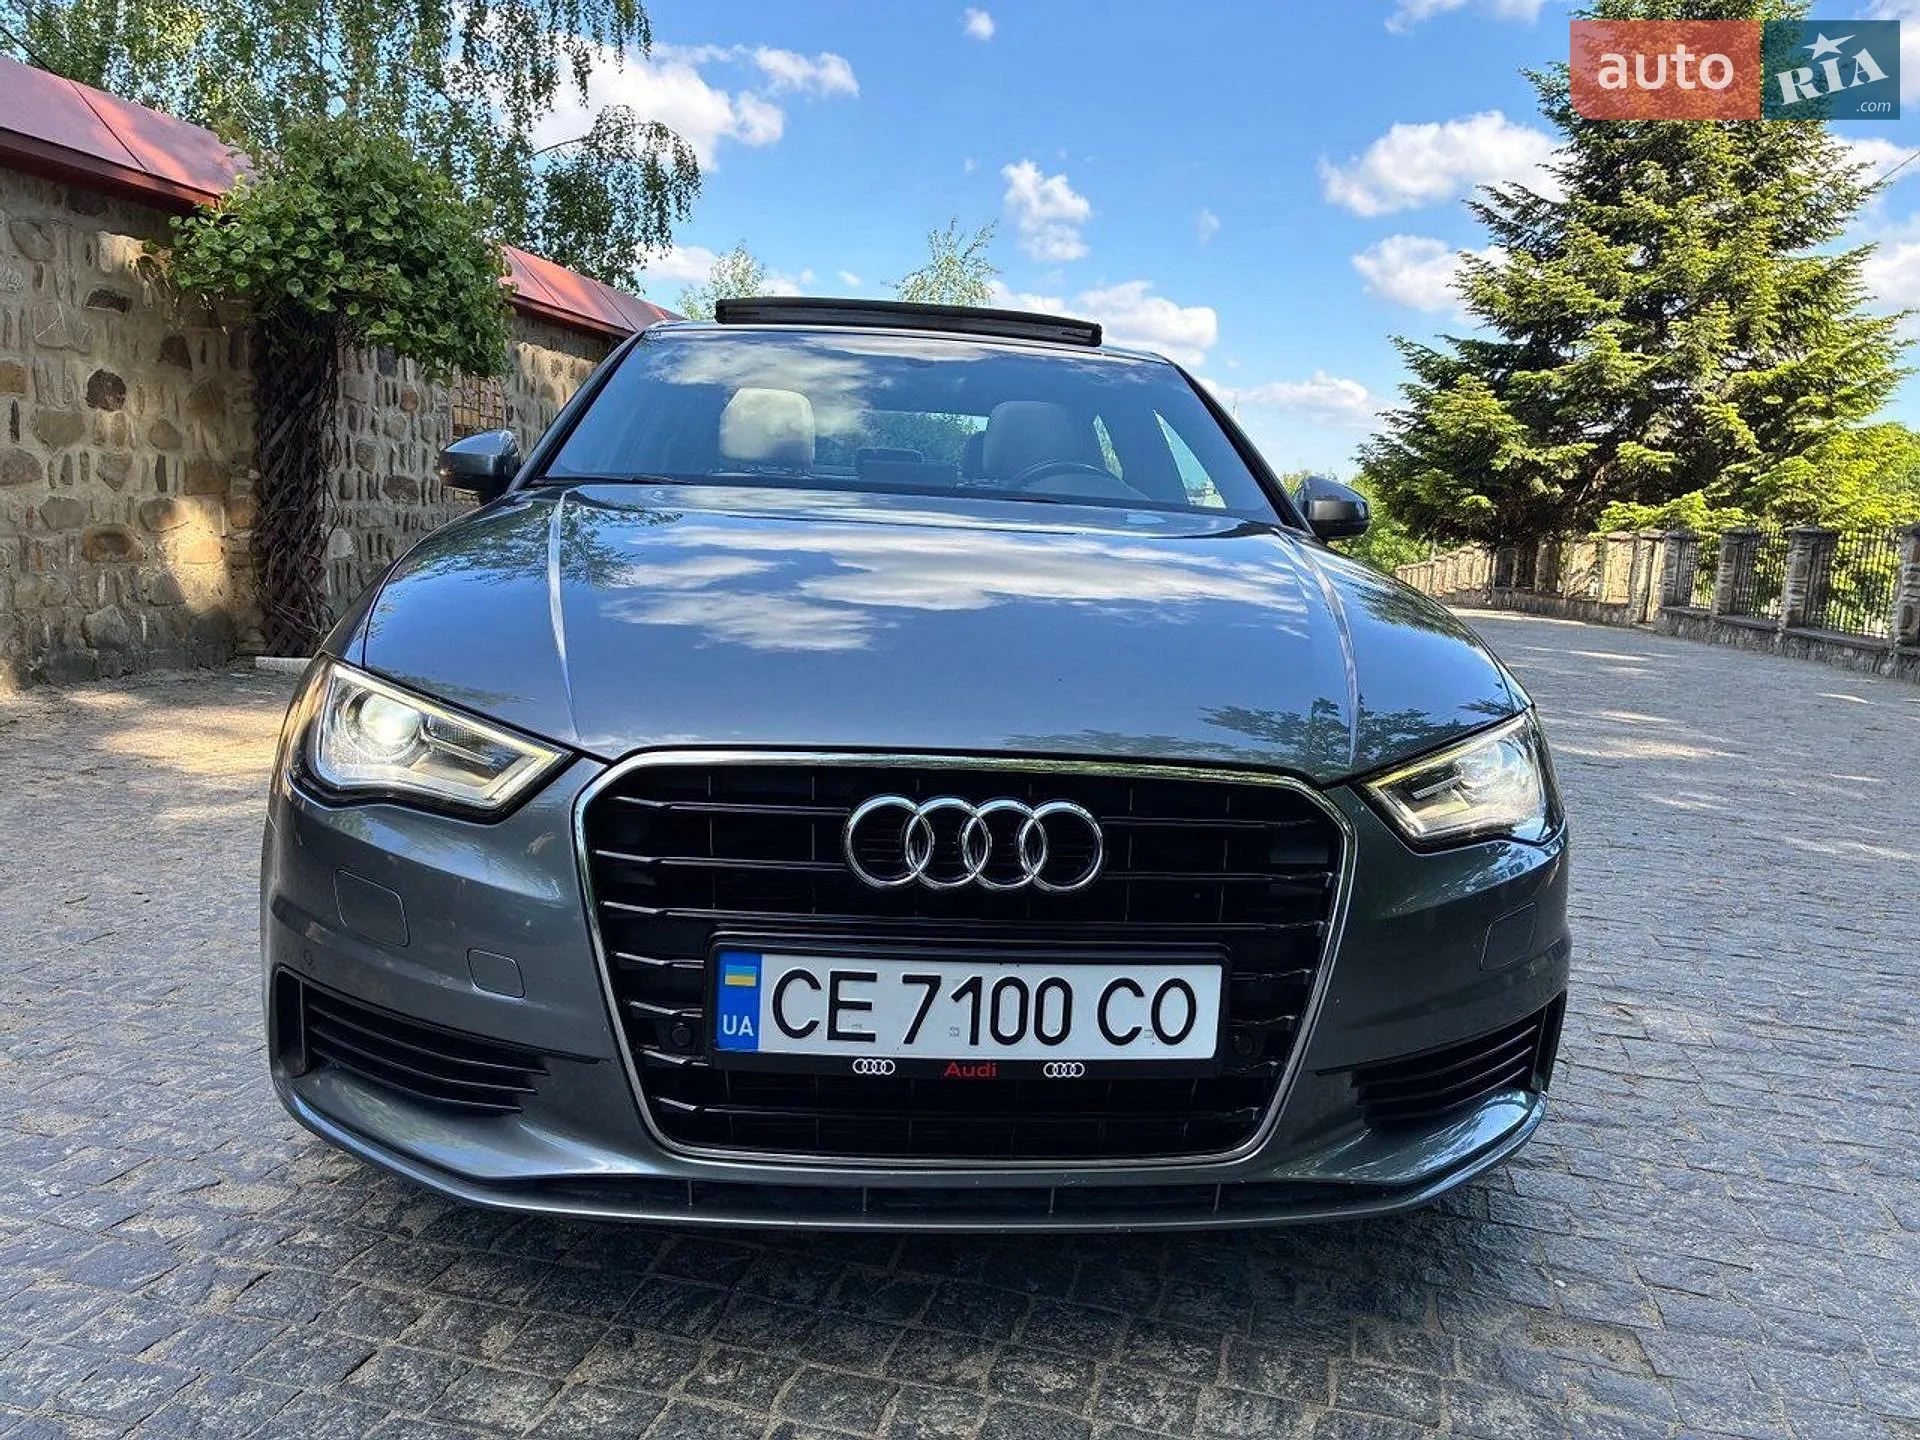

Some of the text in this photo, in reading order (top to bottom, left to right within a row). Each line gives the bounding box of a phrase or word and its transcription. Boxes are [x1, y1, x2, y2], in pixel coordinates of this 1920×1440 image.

[772, 968, 1197, 1046] CE 7100 CO
[722, 1014, 754, 1037] UA
[944, 1061, 997, 1078] Audi
